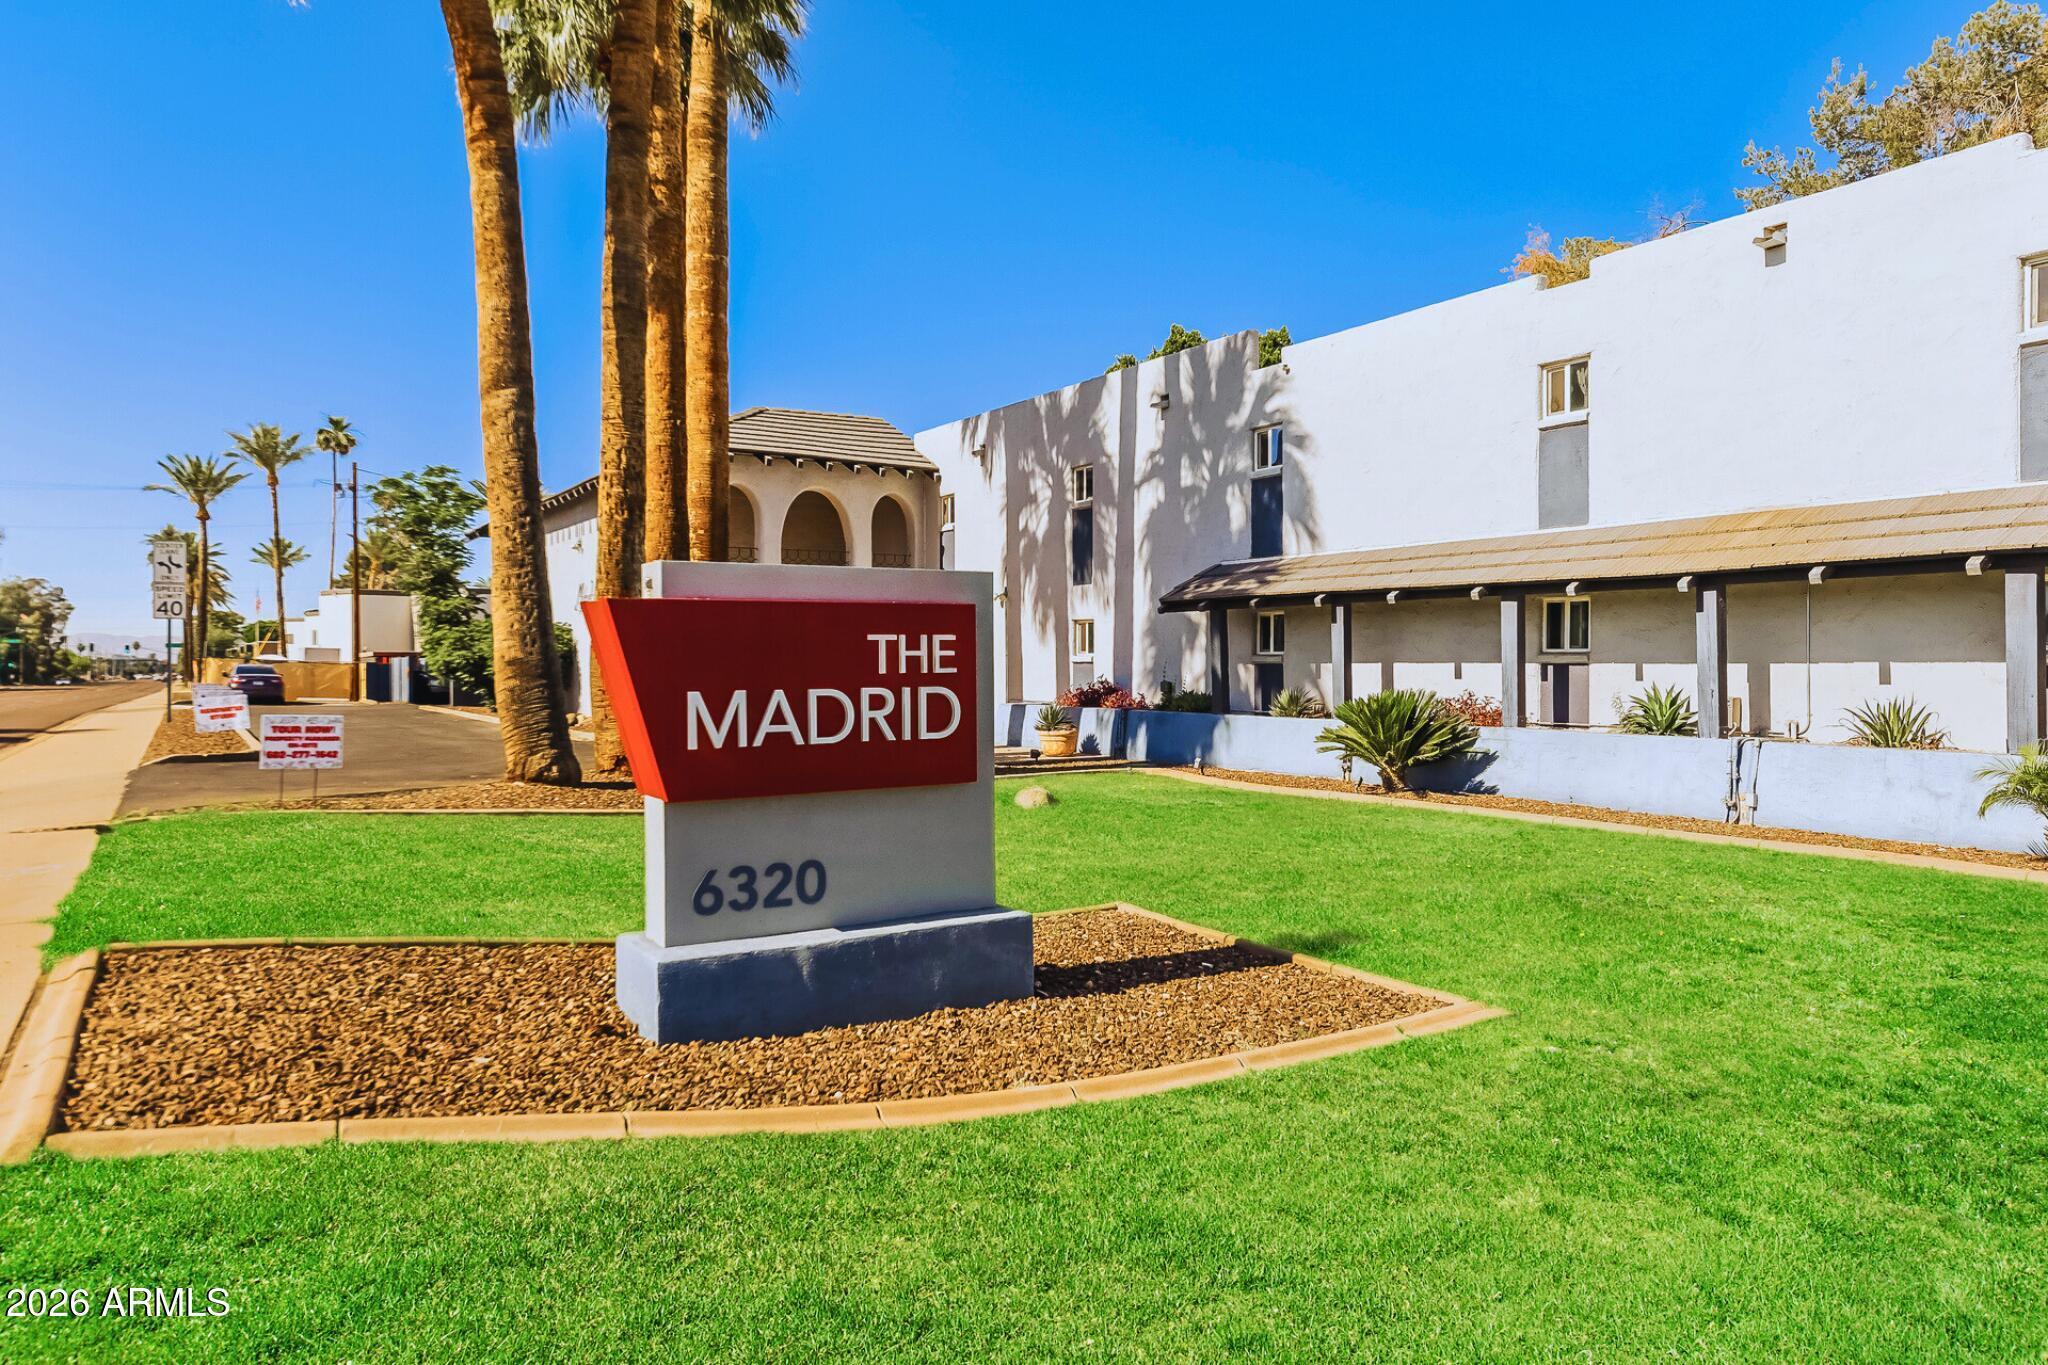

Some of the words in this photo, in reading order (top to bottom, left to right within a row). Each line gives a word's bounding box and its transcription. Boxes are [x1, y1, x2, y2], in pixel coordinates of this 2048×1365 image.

[156, 600, 183, 616] 40
[867, 633, 958, 675] THE
[686, 686, 961, 751] MADRID
[692, 859, 827, 916] 6320
